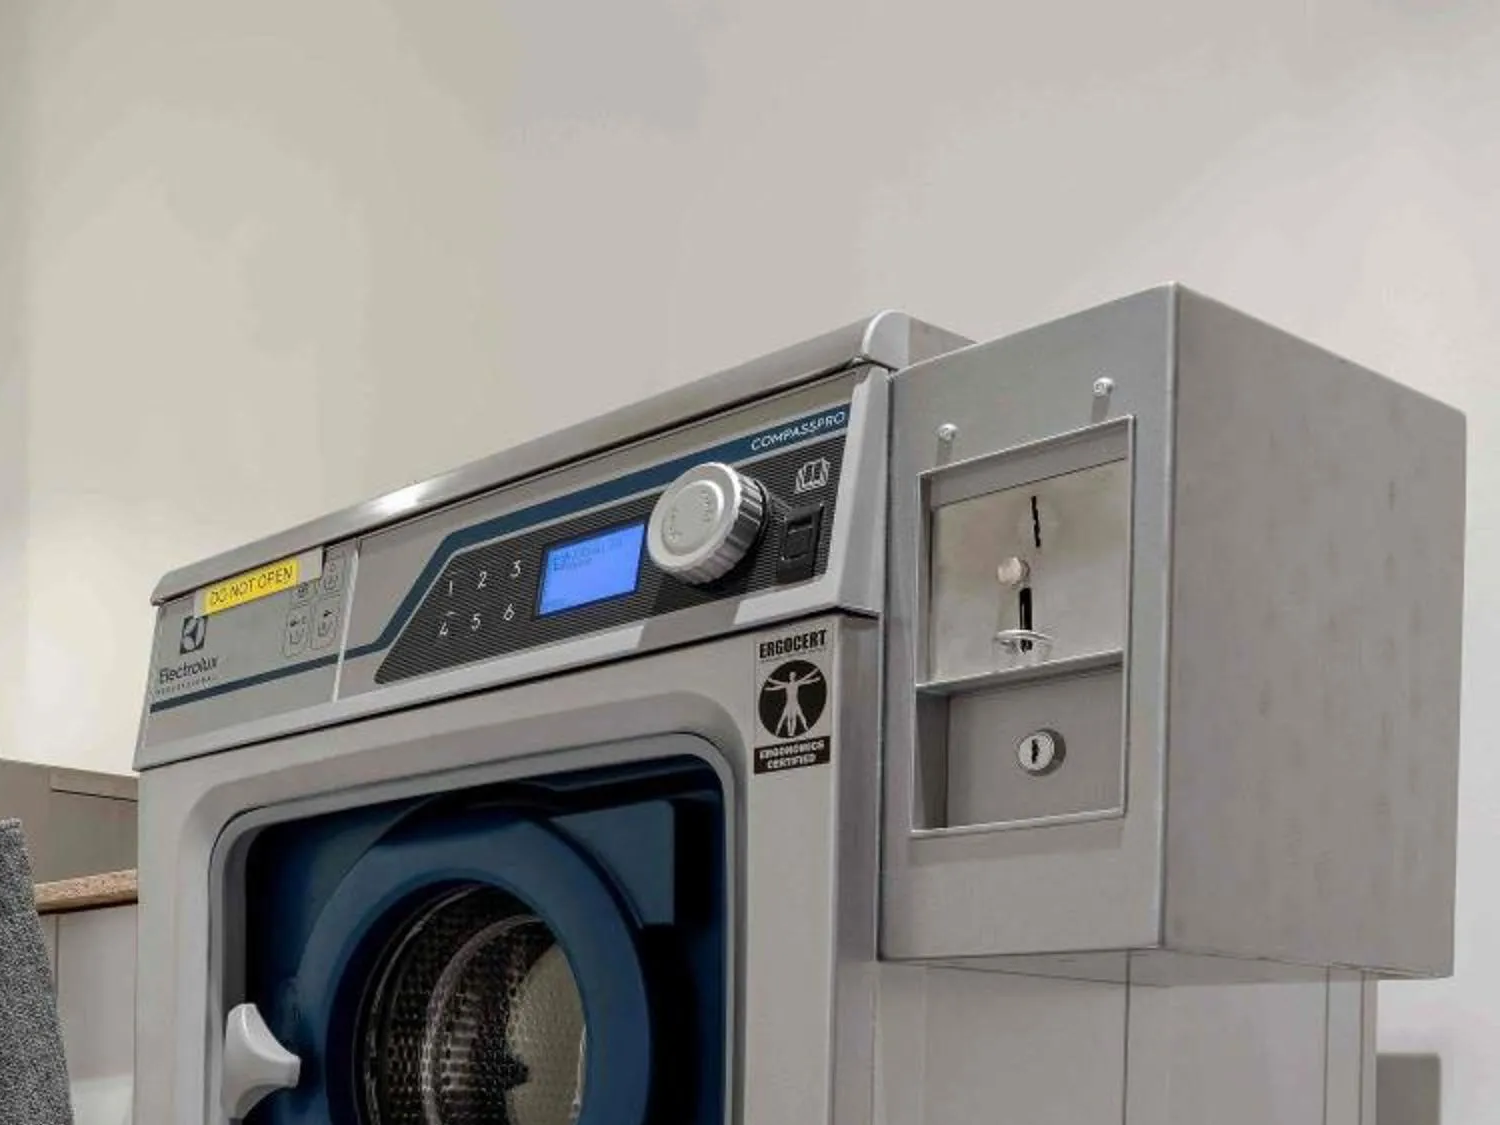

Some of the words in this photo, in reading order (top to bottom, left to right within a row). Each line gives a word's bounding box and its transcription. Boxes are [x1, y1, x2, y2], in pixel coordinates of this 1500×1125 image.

[751, 412, 846, 450] COMPASSPRO
[210, 589, 228, 606] DO
[229, 577, 257, 600] NOT
[258, 565, 294, 589] OPEN
[476, 571, 487, 590] 2
[510, 559, 521, 578] 3
[438, 620, 449, 637] 4
[471, 613, 481, 631] 5
[503, 603, 515, 622] 6
[759, 629, 827, 659] ERGOCERT
[159, 656, 219, 685] Electrolux
